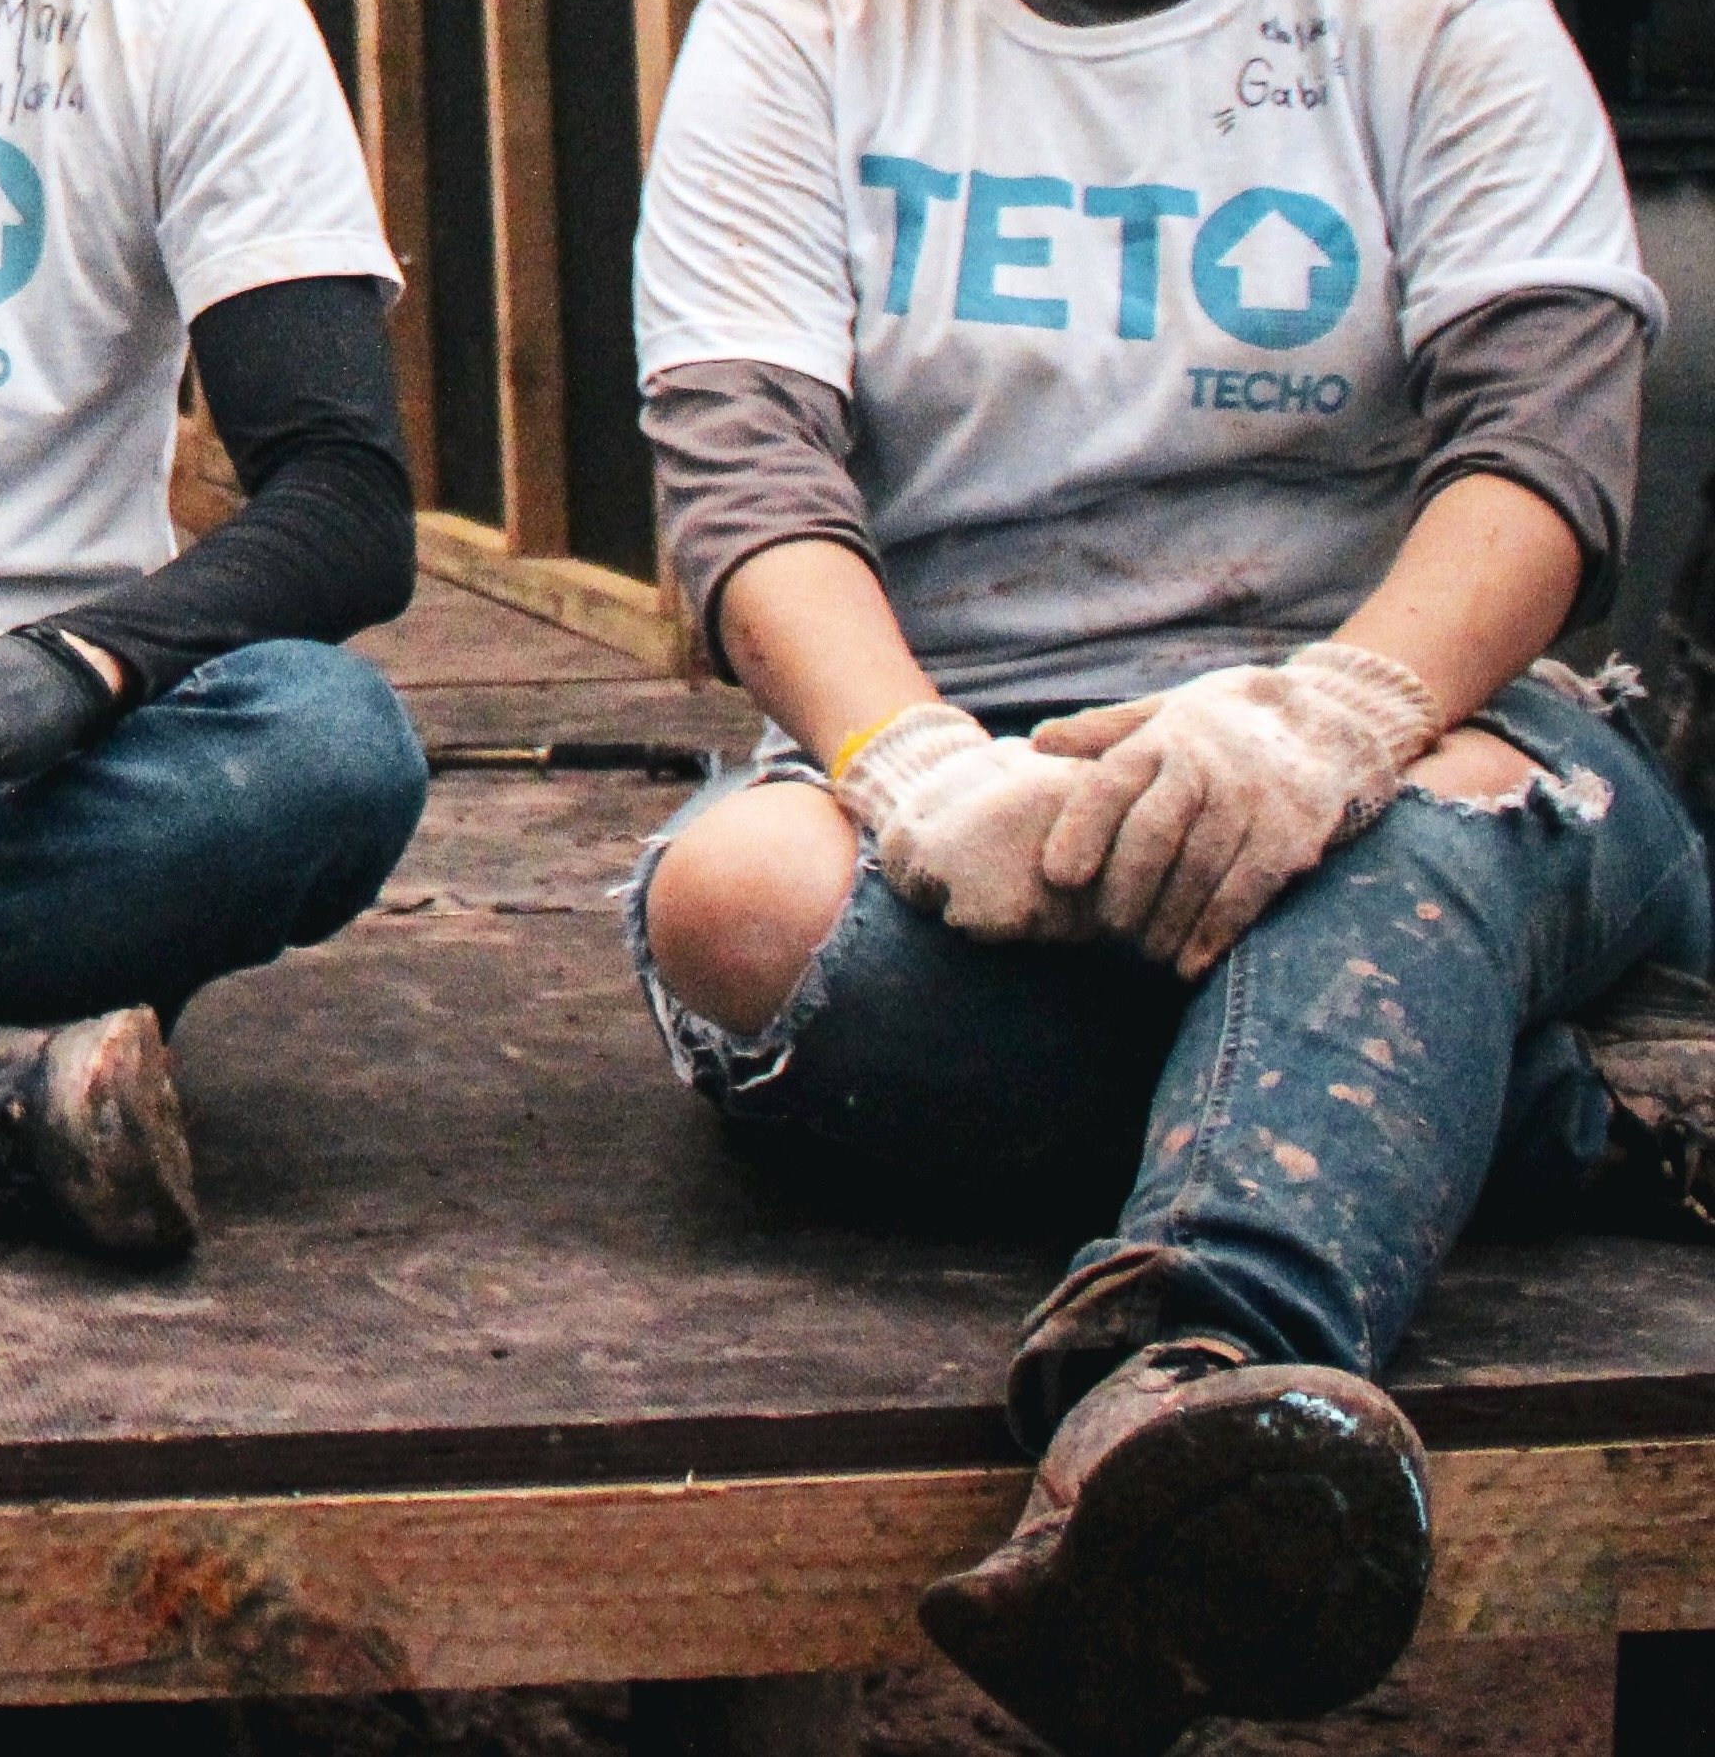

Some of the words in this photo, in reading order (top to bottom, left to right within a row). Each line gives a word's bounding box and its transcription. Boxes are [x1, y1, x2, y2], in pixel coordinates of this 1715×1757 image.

[1235, 56, 1330, 110] Gabi
[860, 154, 1361, 352] TETO
[1187, 367, 1353, 416] TECHO
